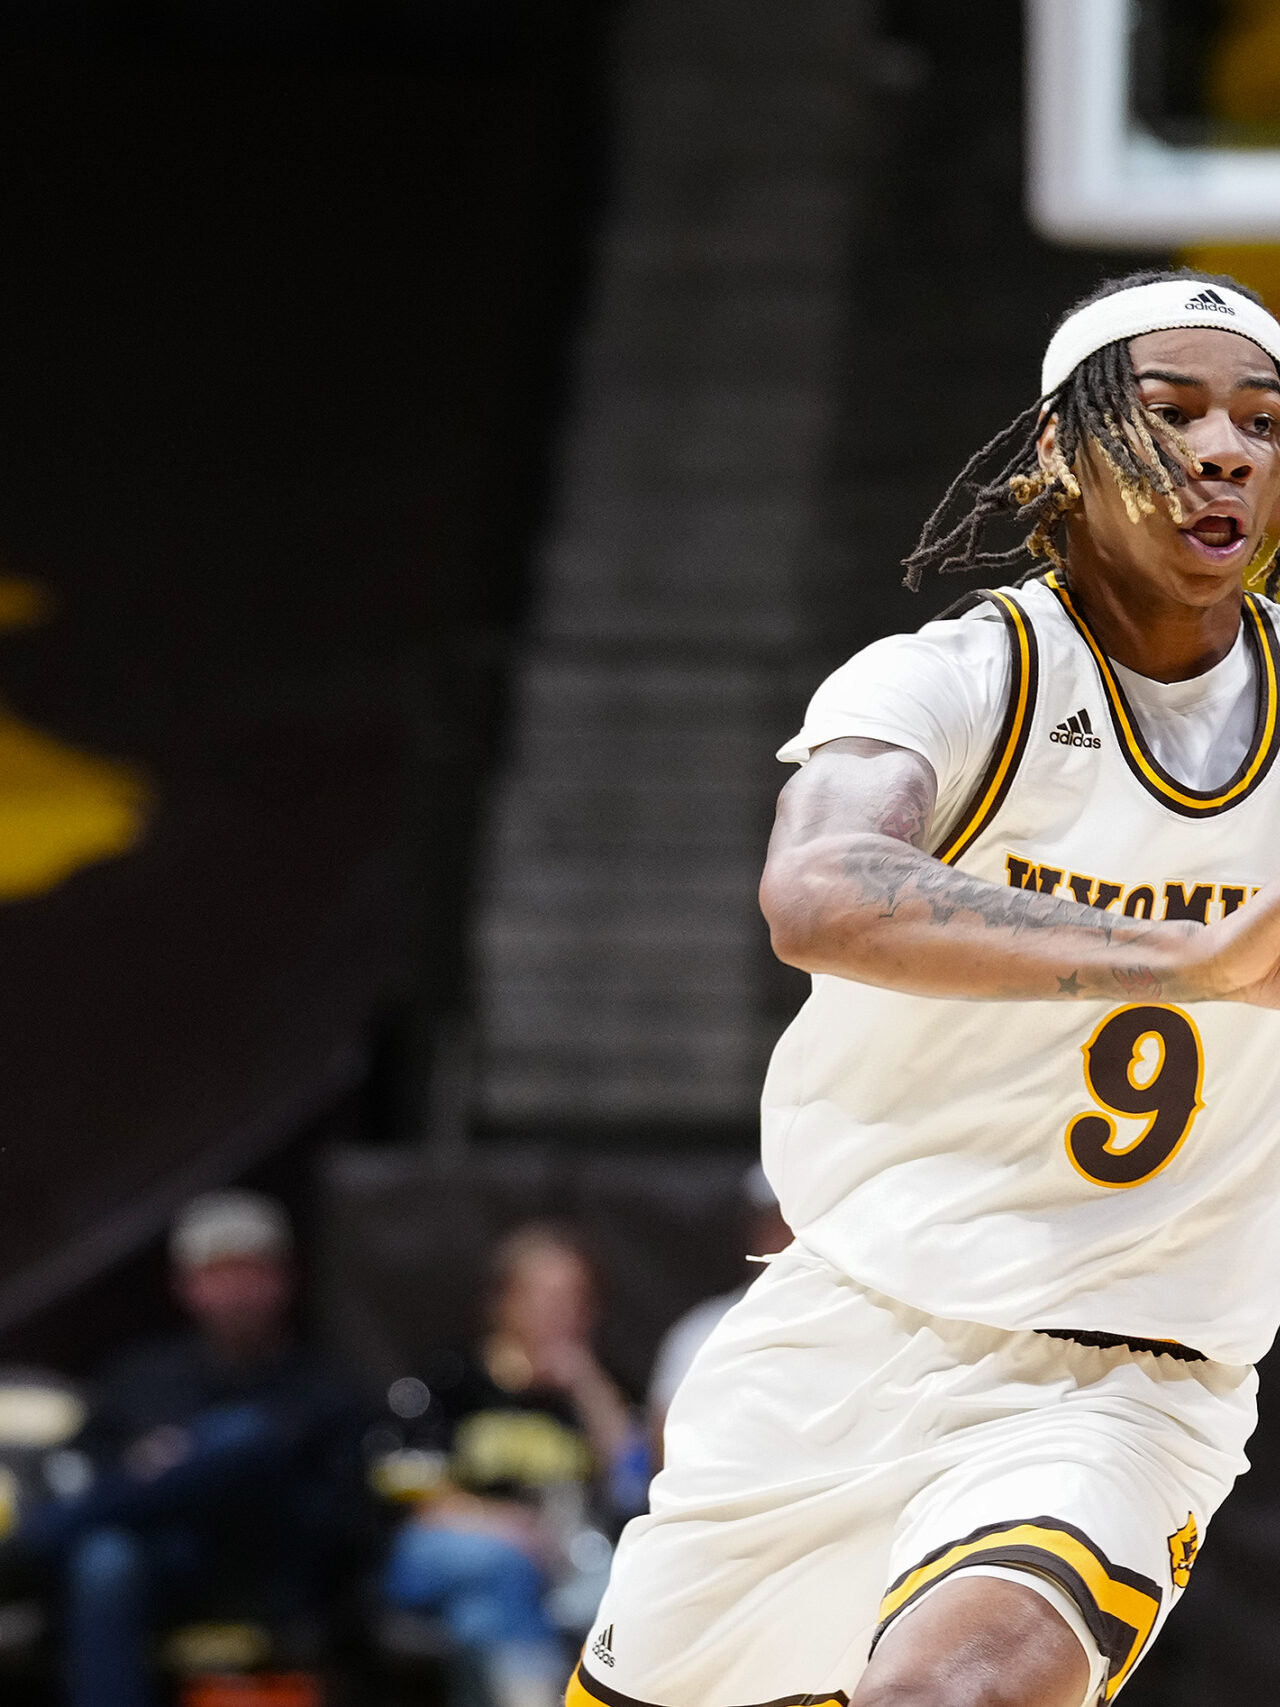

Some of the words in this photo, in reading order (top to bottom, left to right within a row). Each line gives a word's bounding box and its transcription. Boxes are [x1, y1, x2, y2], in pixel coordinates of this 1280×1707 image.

[1184, 300, 1236, 316] adidas
[1049, 729, 1102, 749] adidas
[1064, 1001, 1207, 1189] 9
